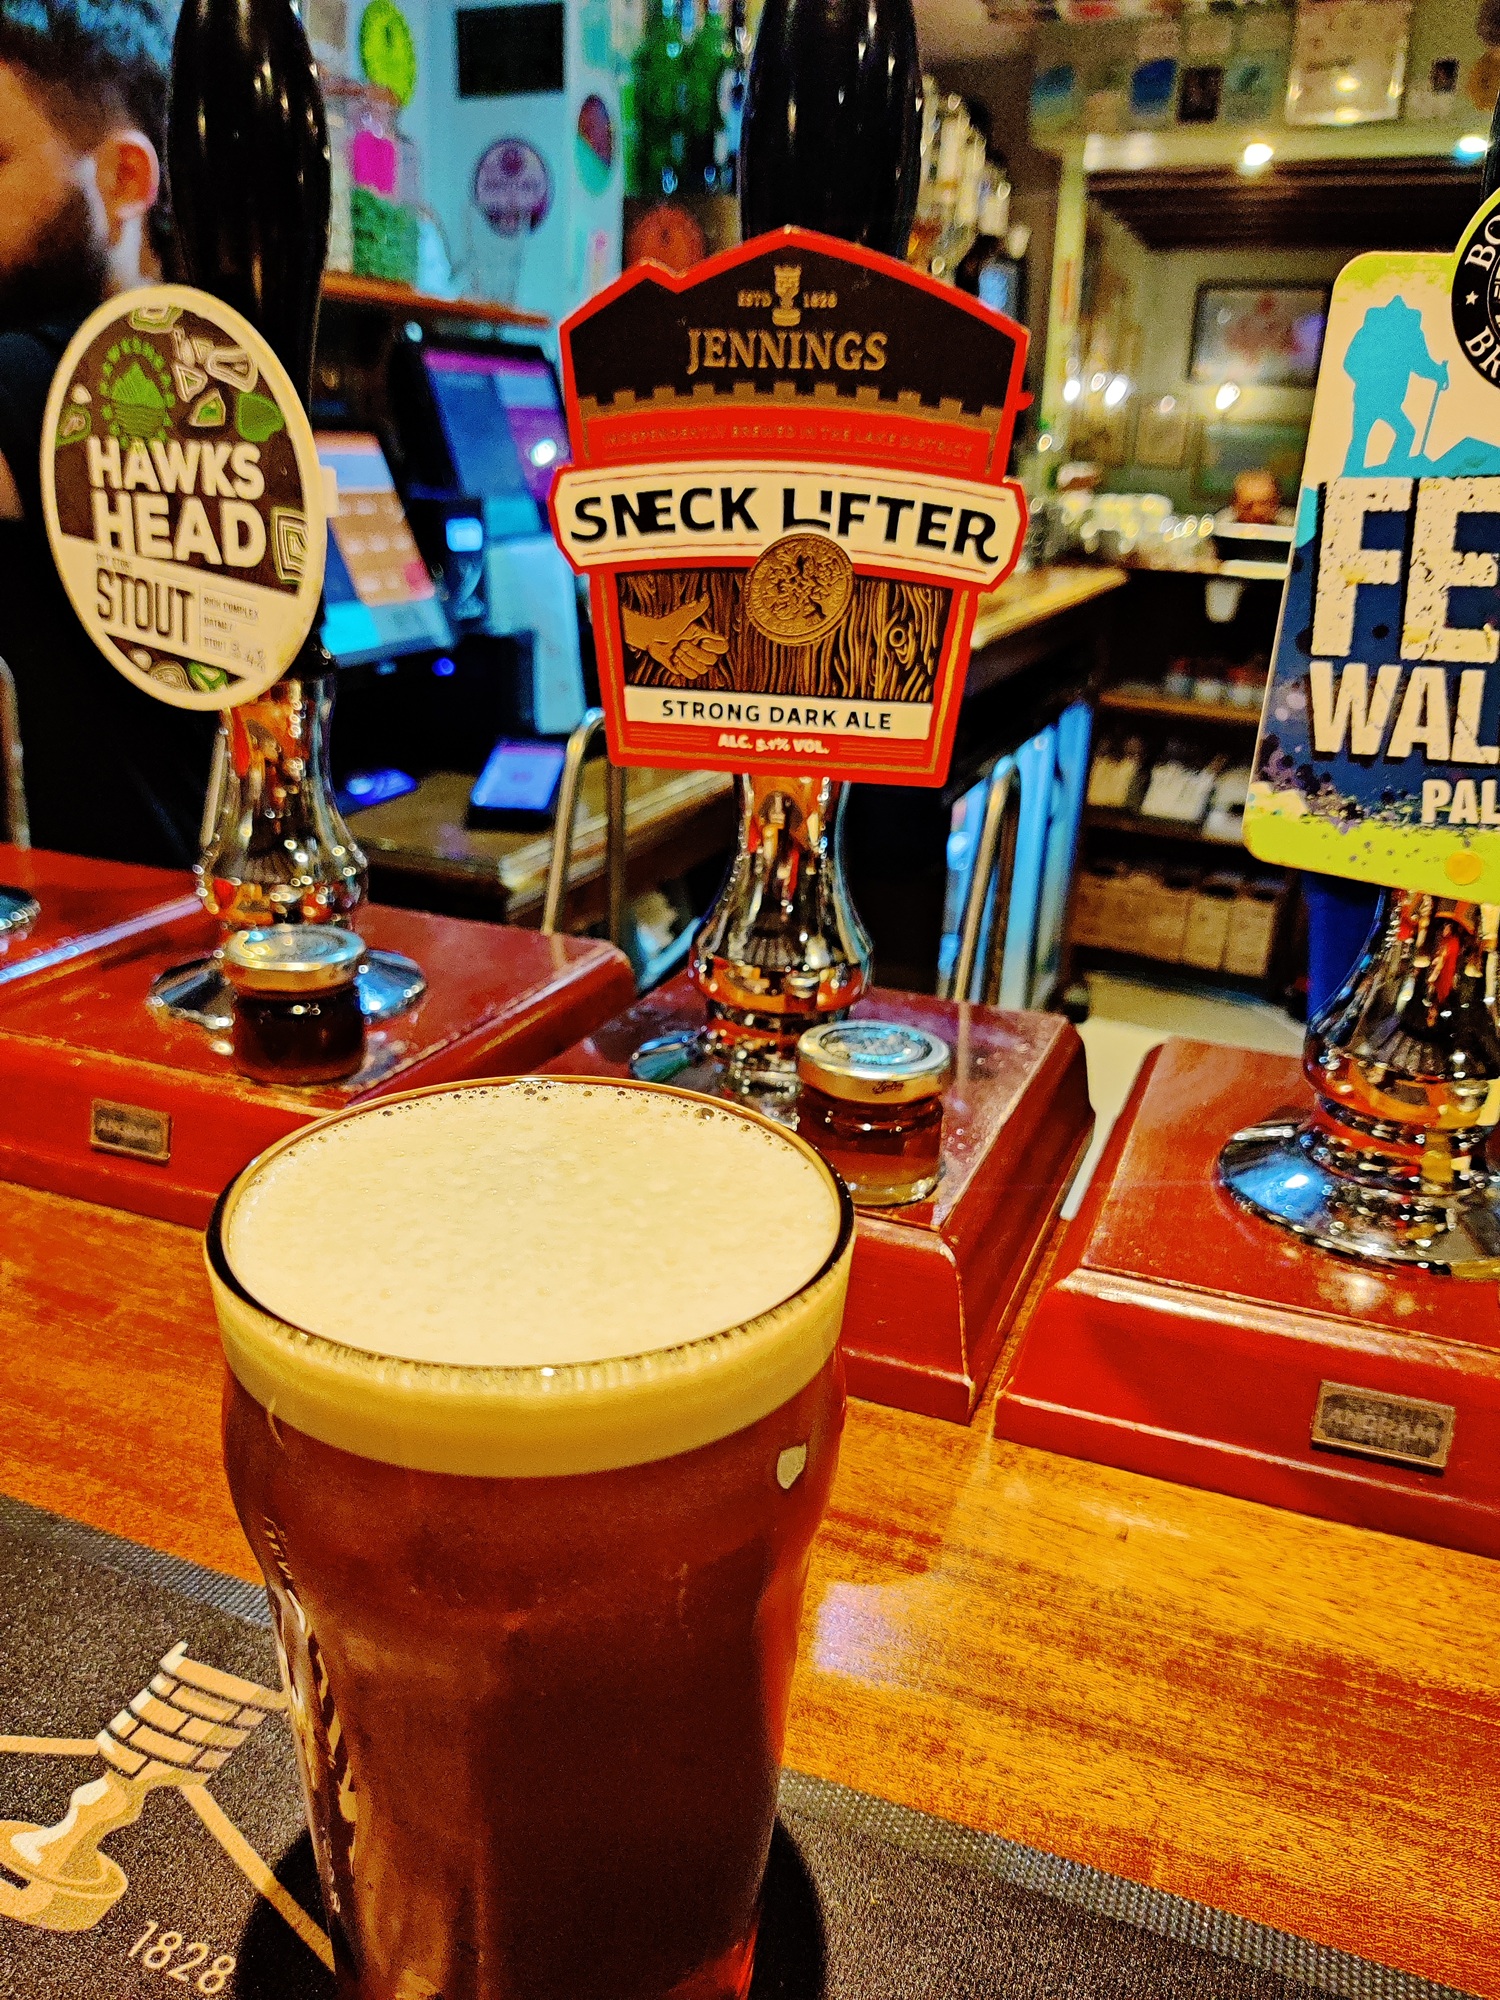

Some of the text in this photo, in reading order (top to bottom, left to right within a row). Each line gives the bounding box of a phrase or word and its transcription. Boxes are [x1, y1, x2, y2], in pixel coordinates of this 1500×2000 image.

[686, 328, 888, 375] JENNINGS
[732, 424, 795, 439] BREWED
[821, 427, 850, 442] THE
[88, 437, 265, 500] HAWKS
[94, 489, 267, 567] HEAD
[571, 487, 998, 564] SNECK LIFTER
[1310, 477, 1500, 663] FE
[97, 567, 194, 645] STOUT
[661, 699, 891, 730] STRONG DARK ALE
[718, 733, 753, 749] ALC.
[793, 738, 830, 754] VOL.
[1309, 661, 1500, 765] WAL
[1421, 778, 1500, 825] PAL
[128, 1920, 236, 1994] 1828
